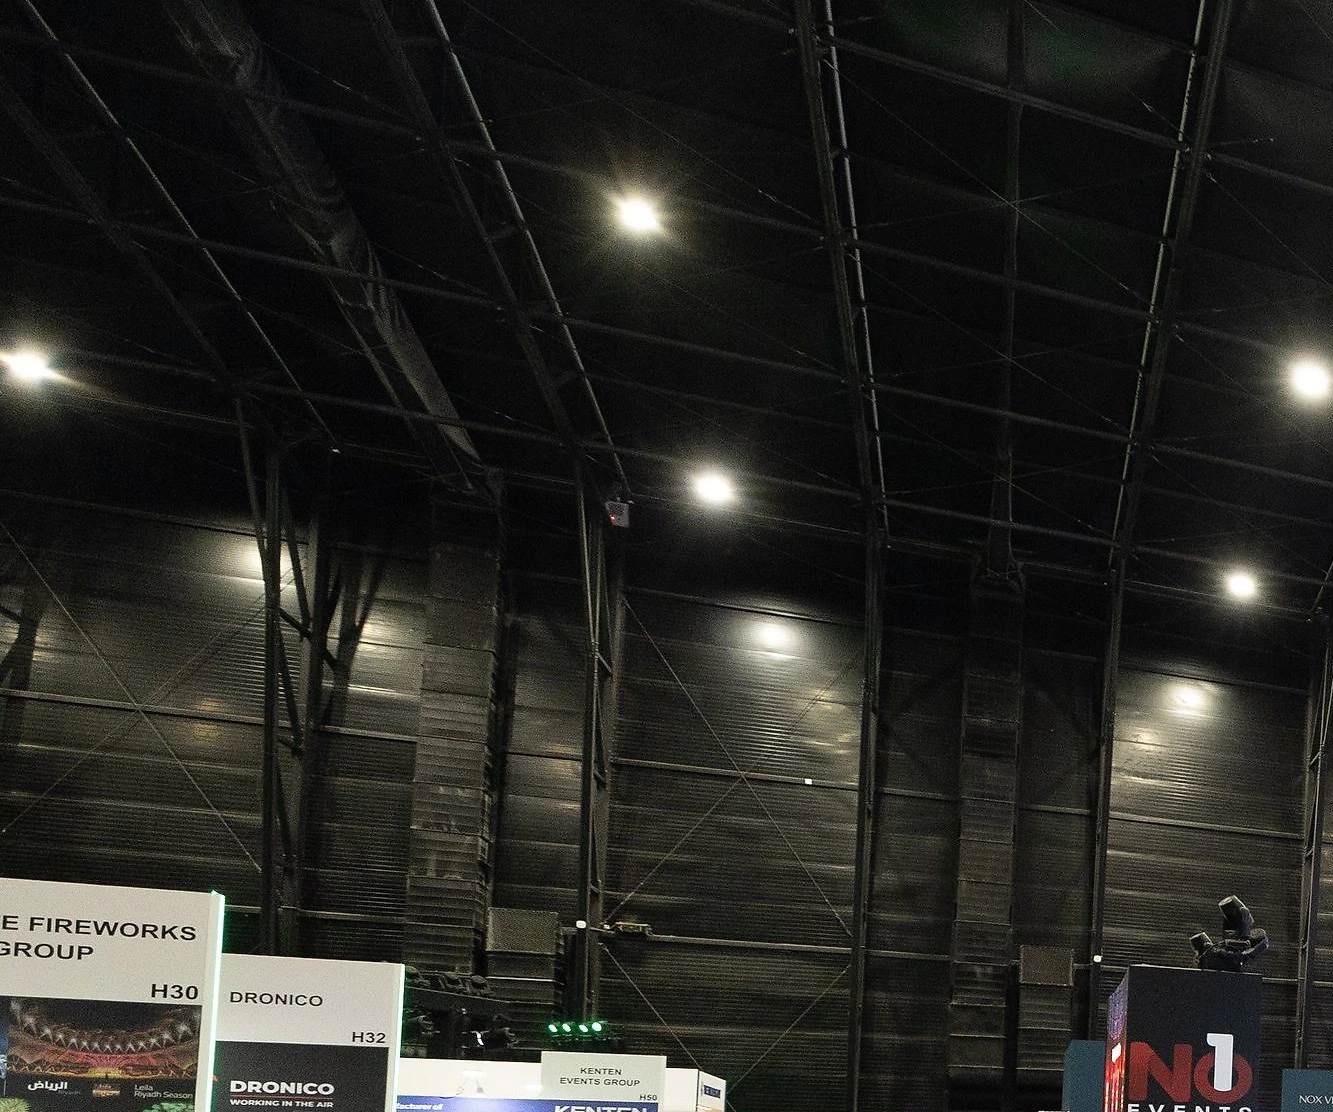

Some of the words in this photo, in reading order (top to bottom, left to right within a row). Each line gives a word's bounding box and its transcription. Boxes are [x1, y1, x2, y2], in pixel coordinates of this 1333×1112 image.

[0, 914, 19, 931] E
[29, 916, 197, 942] FIREWORKS
[151, 983, 199, 1001] H30
[230, 991, 324, 1007] DRONICO
[352, 1031, 386, 1044] H32
[580, 1067, 623, 1076] KENTEN
[27, 1080, 69, 1092] الرياض
[560, 1077, 601, 1086] EVENTS
[603, 1078, 641, 1087] GROUP
[230, 1080, 335, 1096] DRONICO
[133, 1091, 162, 1099] Riyadh
[163, 1091, 194, 1099] Season
[1299, 1095, 1323, 1105] NOX
[230, 1098, 280, 1107] WORKING
[295, 1100, 314, 1108] THE
[395, 1102, 432, 1111] facturer
